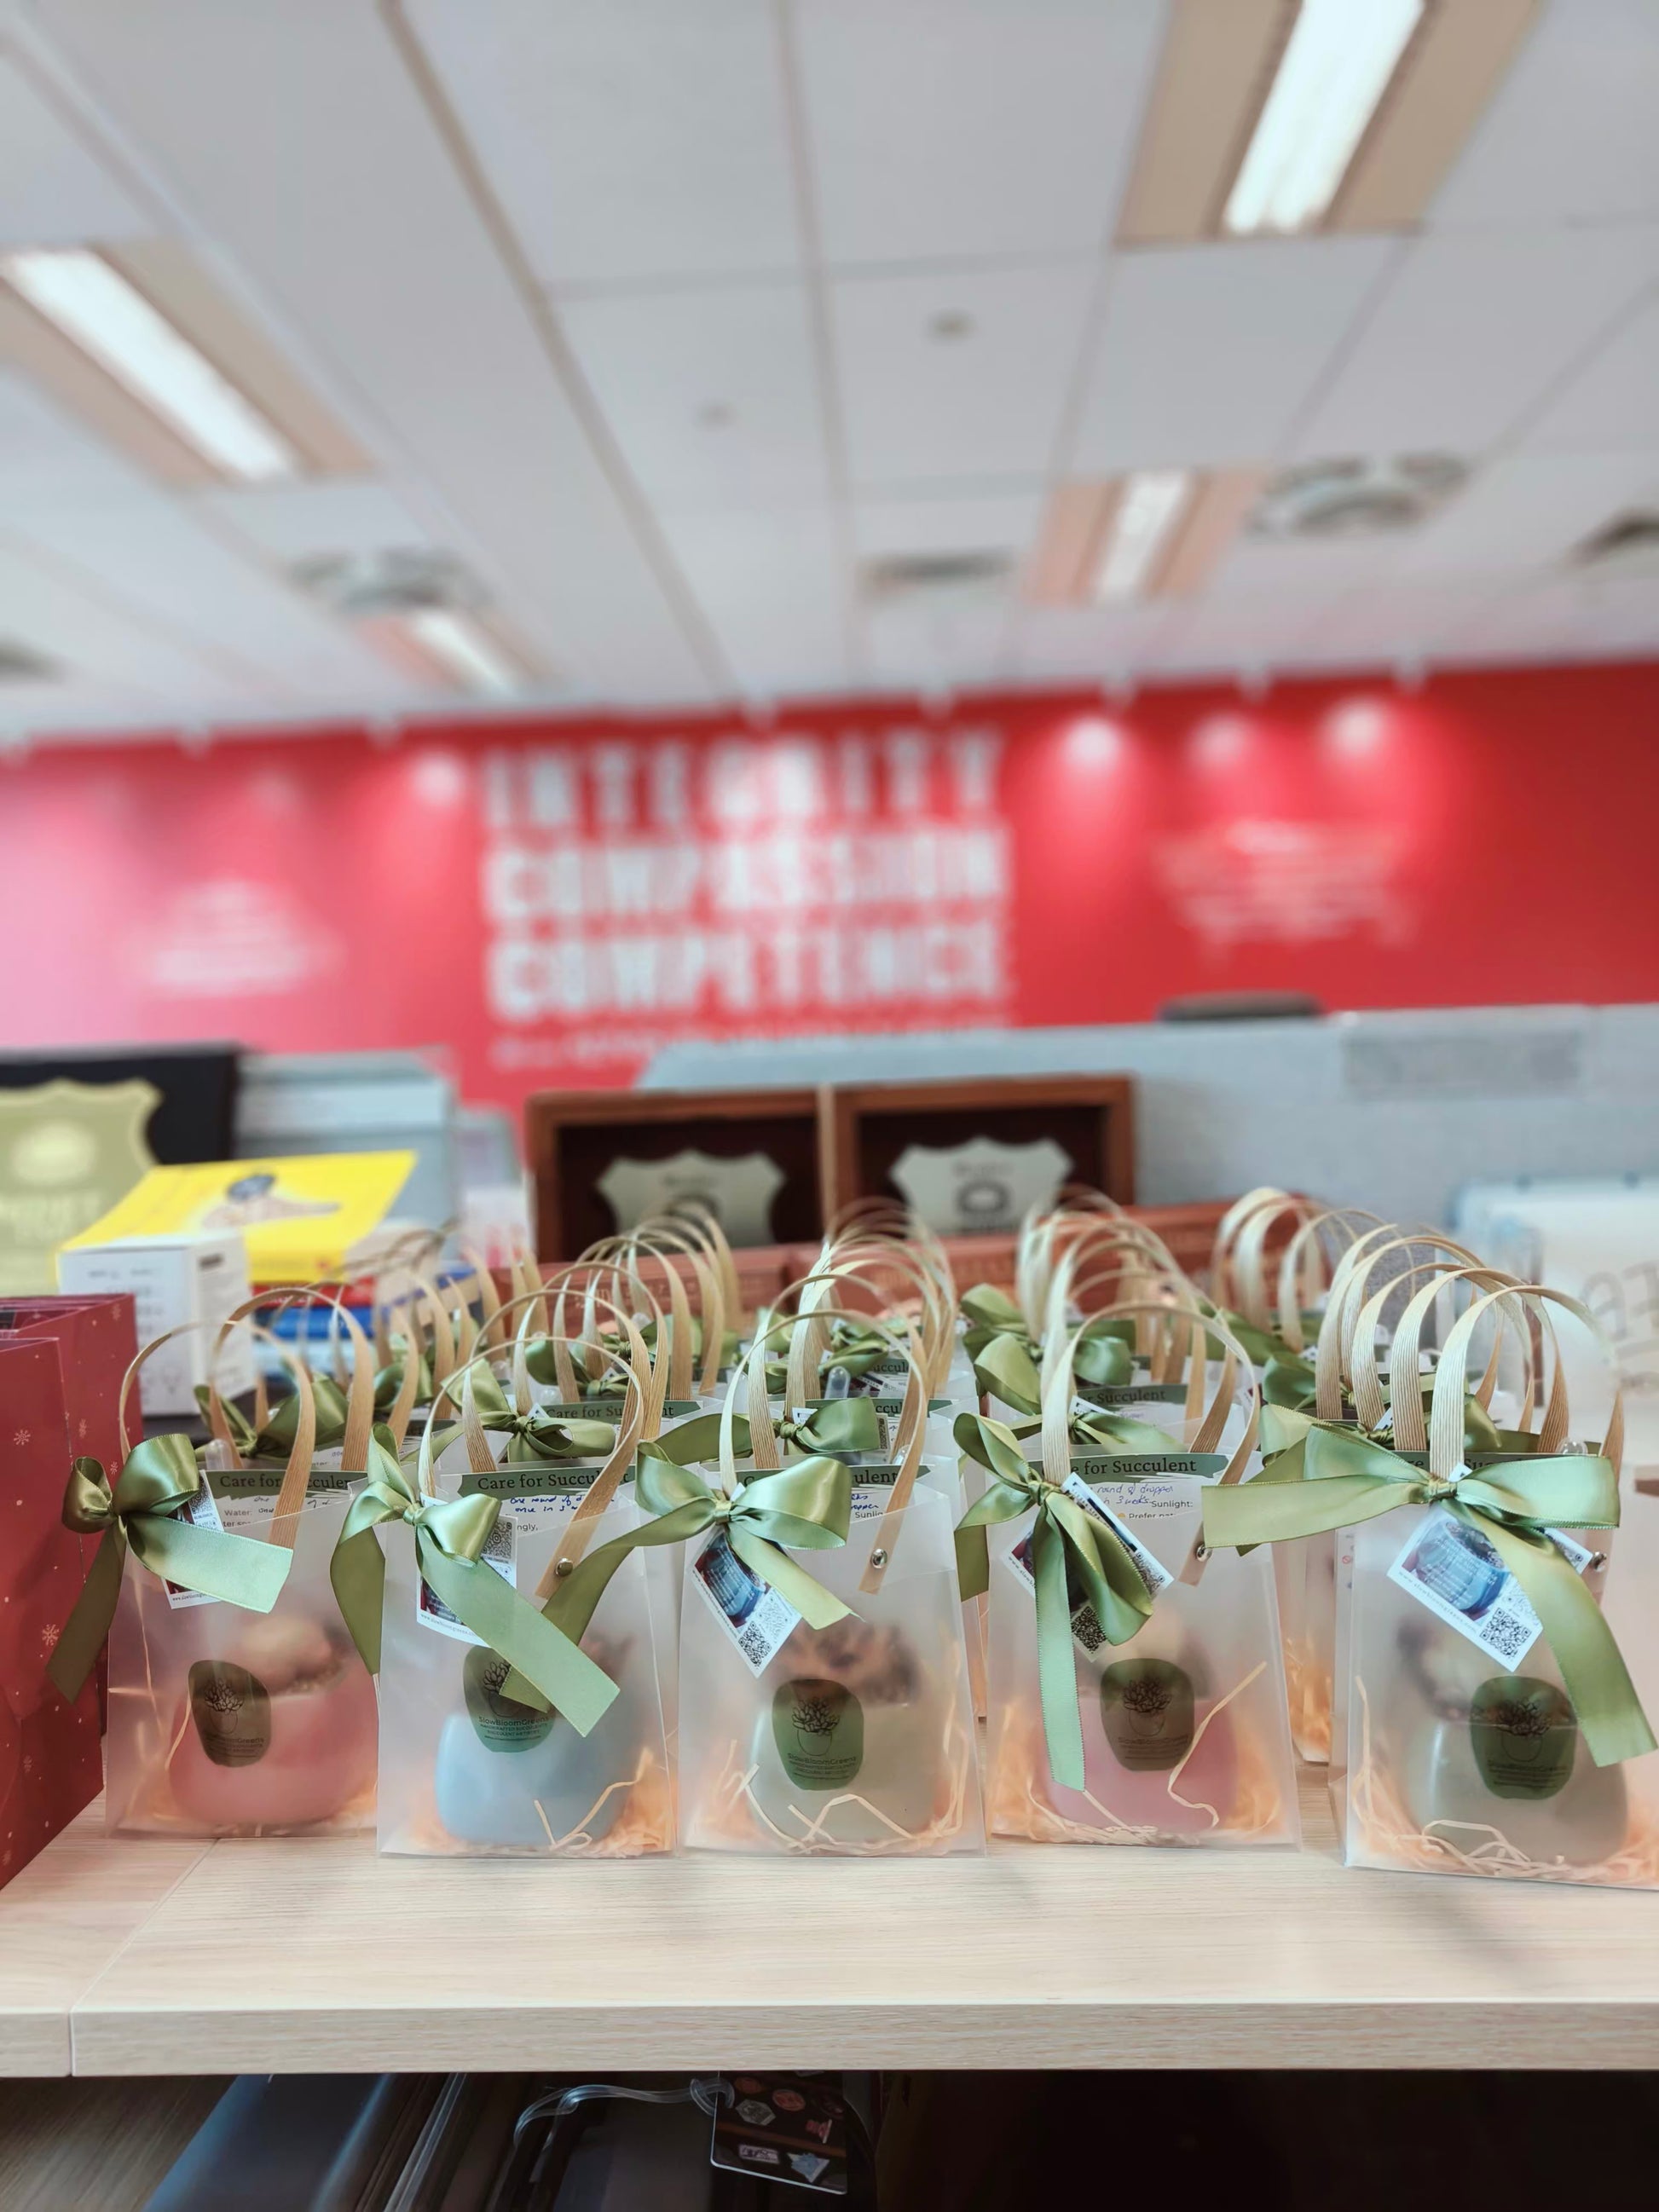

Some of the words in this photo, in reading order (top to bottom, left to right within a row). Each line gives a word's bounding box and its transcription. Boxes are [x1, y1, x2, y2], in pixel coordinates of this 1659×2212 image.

[1096, 1389, 1166, 1404] Succulent
[582, 1406, 600, 1418] for
[1084, 1461, 1107, 1475] for
[1113, 1458, 1197, 1474] Succulent
[220, 1475, 256, 1488] Care
[260, 1474, 280, 1487] for
[477, 1477, 515, 1490] Care
[520, 1474, 543, 1488] for
[1151, 1500, 1194, 1510] Sunlight:
